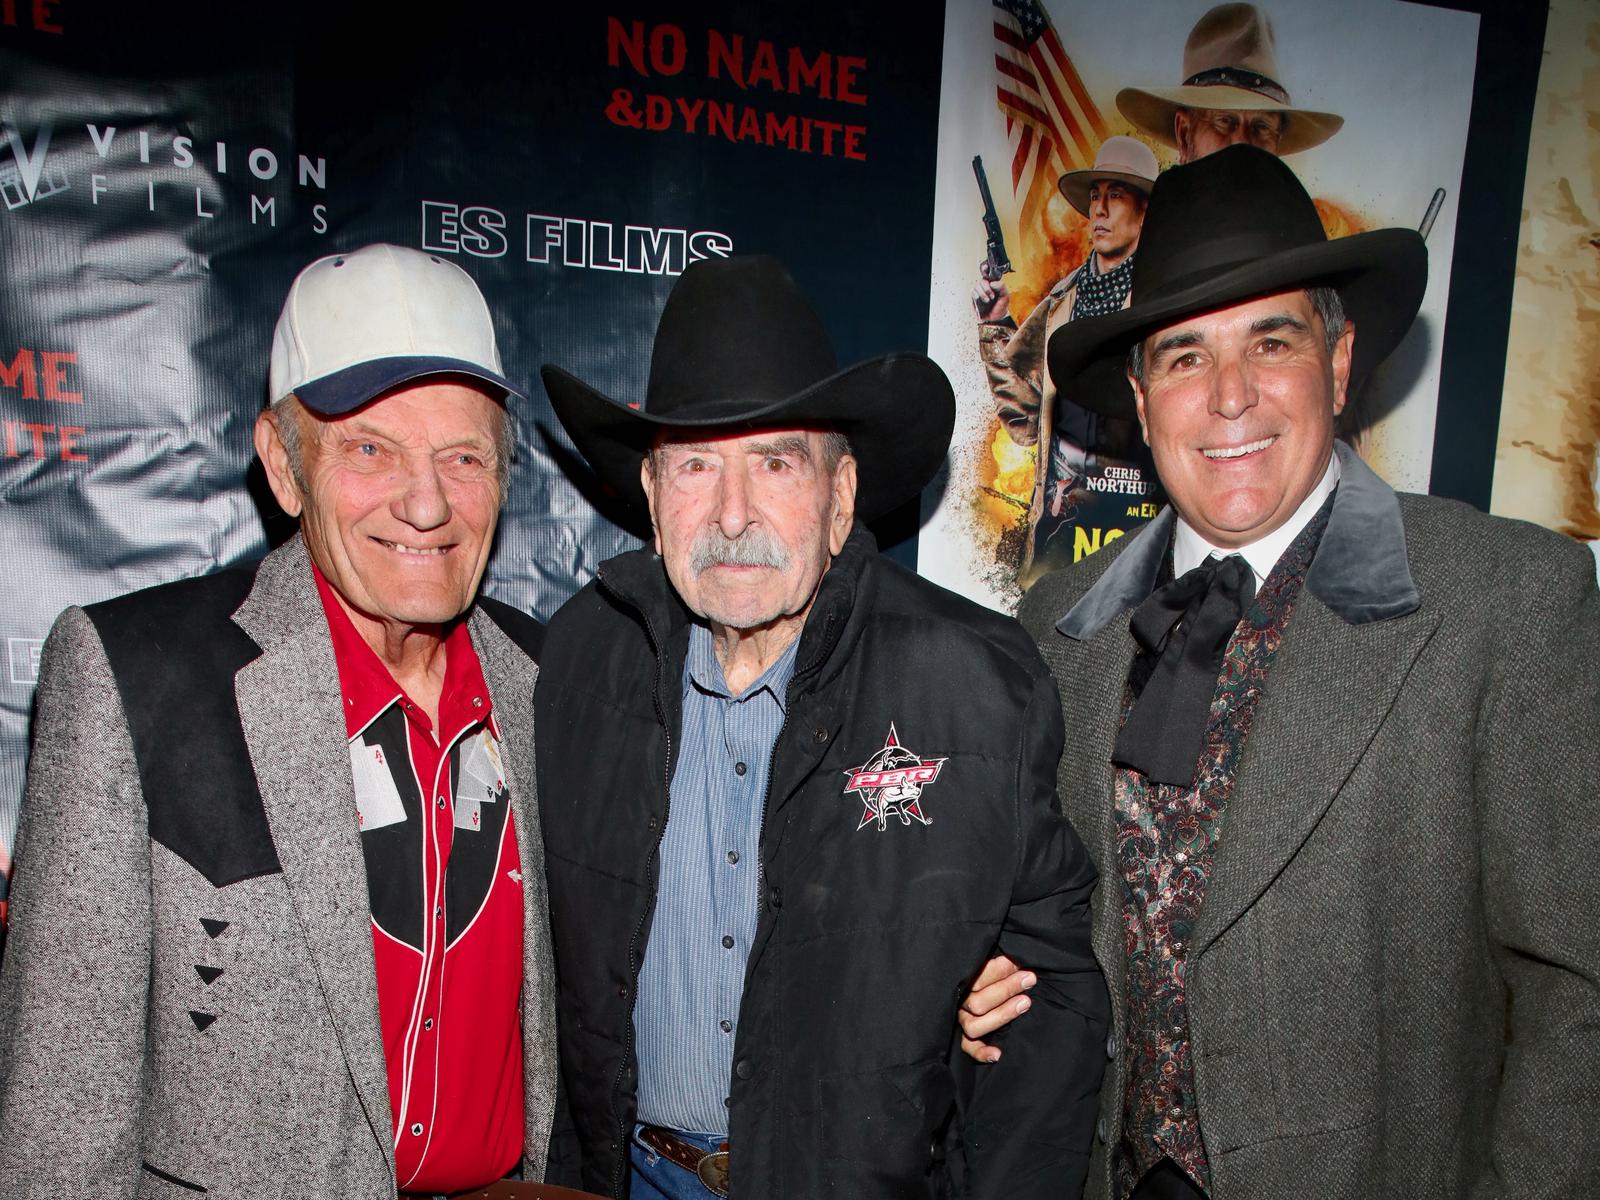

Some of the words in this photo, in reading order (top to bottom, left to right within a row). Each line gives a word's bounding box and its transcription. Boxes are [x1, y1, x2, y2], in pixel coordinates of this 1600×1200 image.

[606, 15, 688, 77] NO
[708, 28, 868, 106] NAME
[604, 87, 868, 161] &DYNAMITE
[86, 123, 326, 189] VISION
[91, 174, 328, 234] FILMS
[421, 200, 508, 258] ES
[1103, 466, 1142, 481] CHRIS
[1126, 505, 1139, 518] AN
[855, 767, 936, 786] PBR
